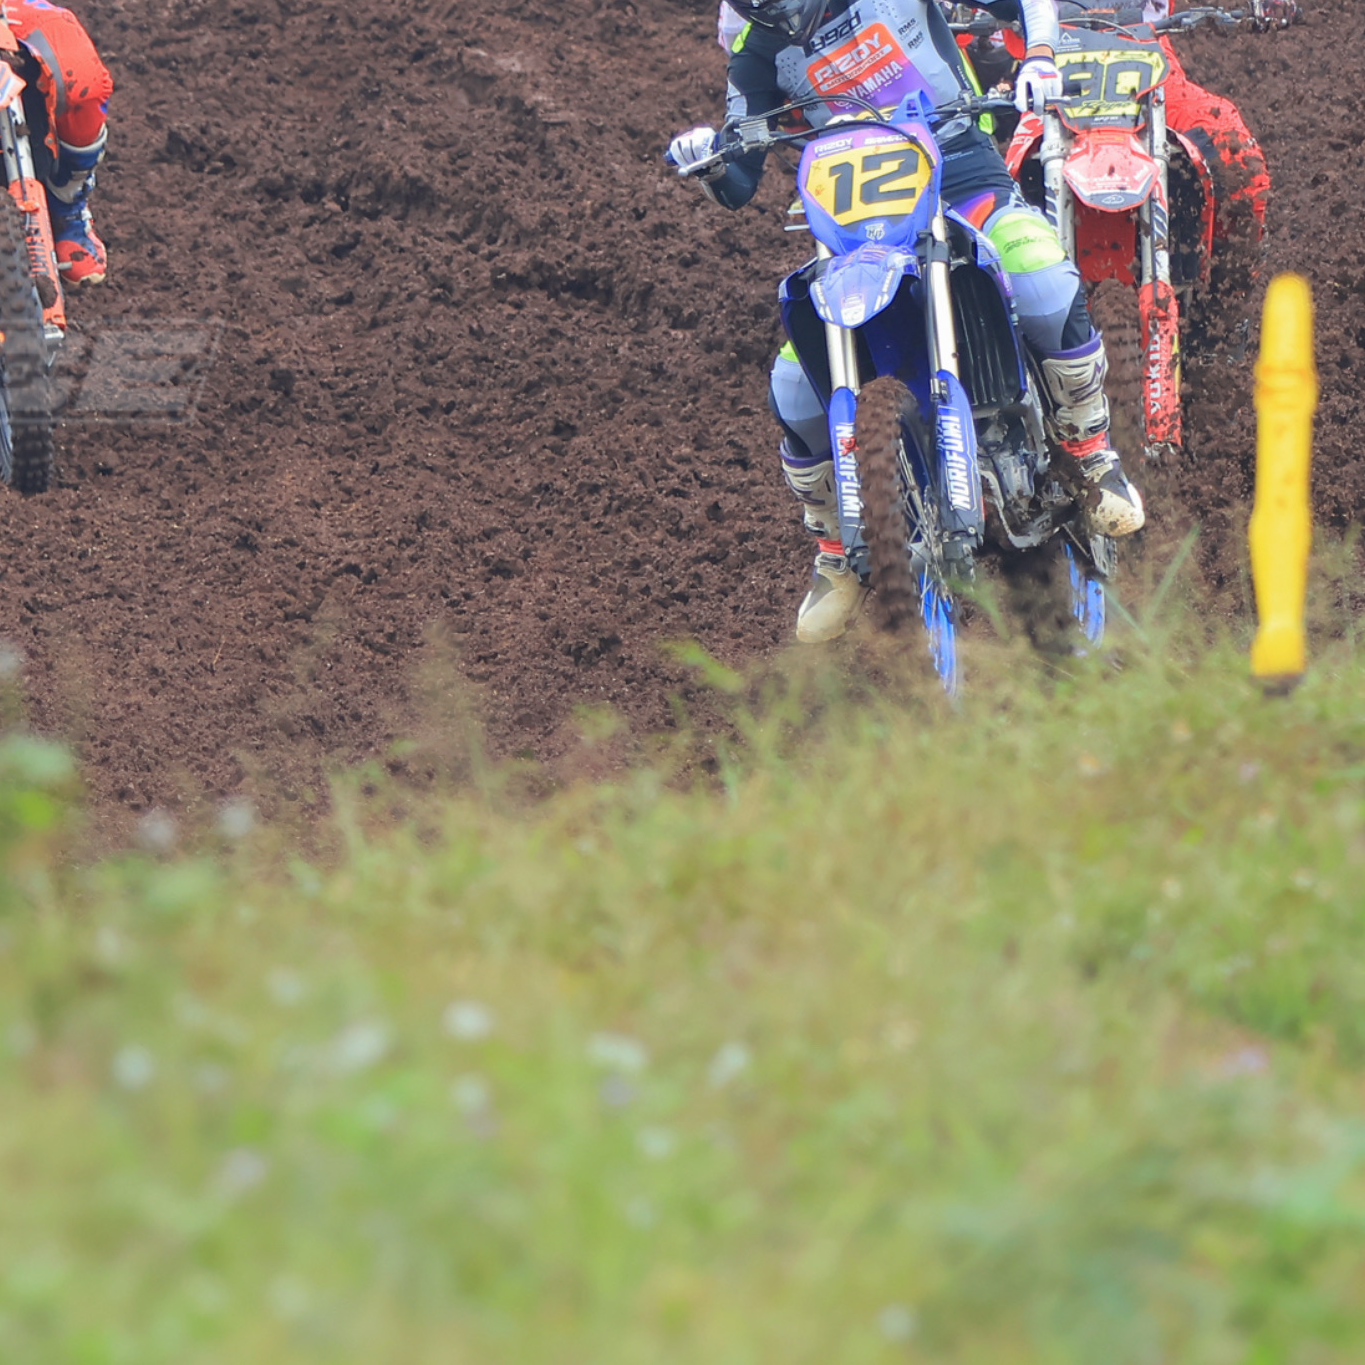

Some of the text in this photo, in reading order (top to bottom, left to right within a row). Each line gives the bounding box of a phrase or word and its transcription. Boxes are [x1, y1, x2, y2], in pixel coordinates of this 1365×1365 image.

[896, 17, 917, 36] RMS
[846, 60, 904, 99] YAMAHA
[828, 147, 920, 217] 12
[937, 414, 972, 511] NORIFUMI
